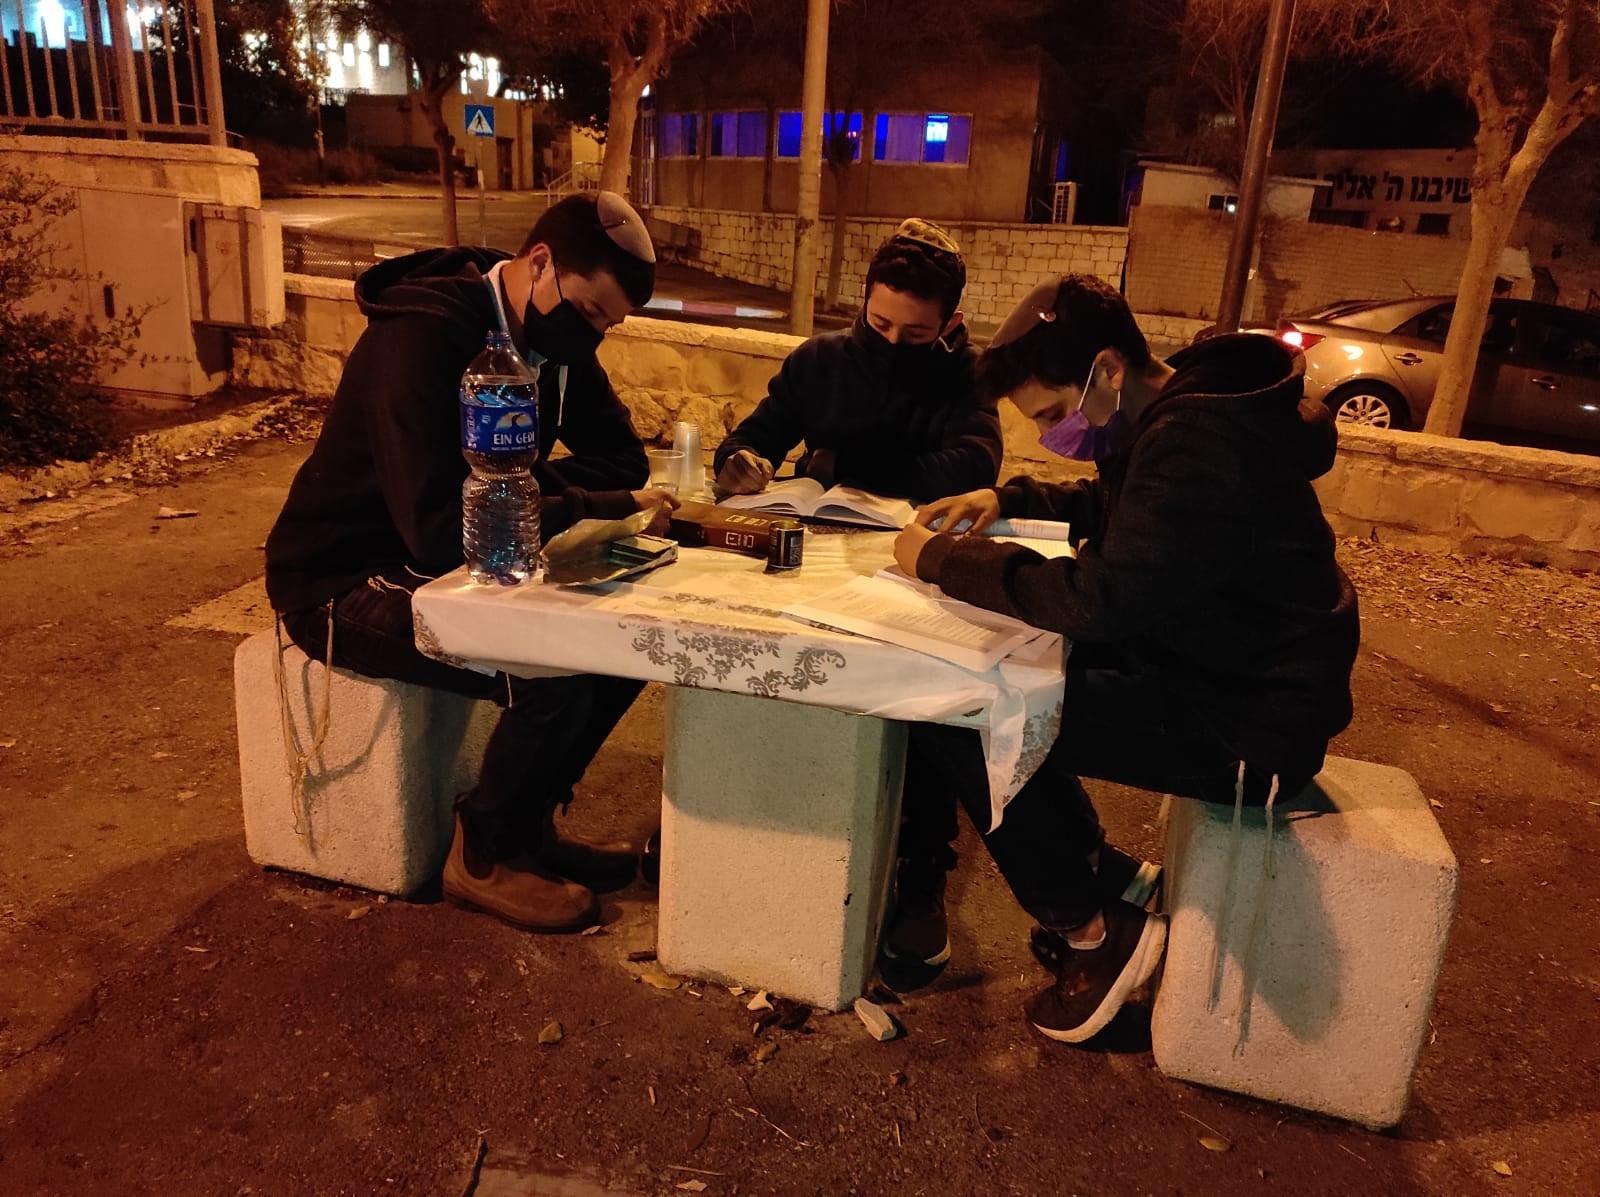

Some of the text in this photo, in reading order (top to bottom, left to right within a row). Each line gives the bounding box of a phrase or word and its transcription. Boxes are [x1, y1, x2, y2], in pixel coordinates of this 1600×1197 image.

[1409, 175, 1472, 203] שיבנו
[494, 431, 535, 445] EIN GEDI
